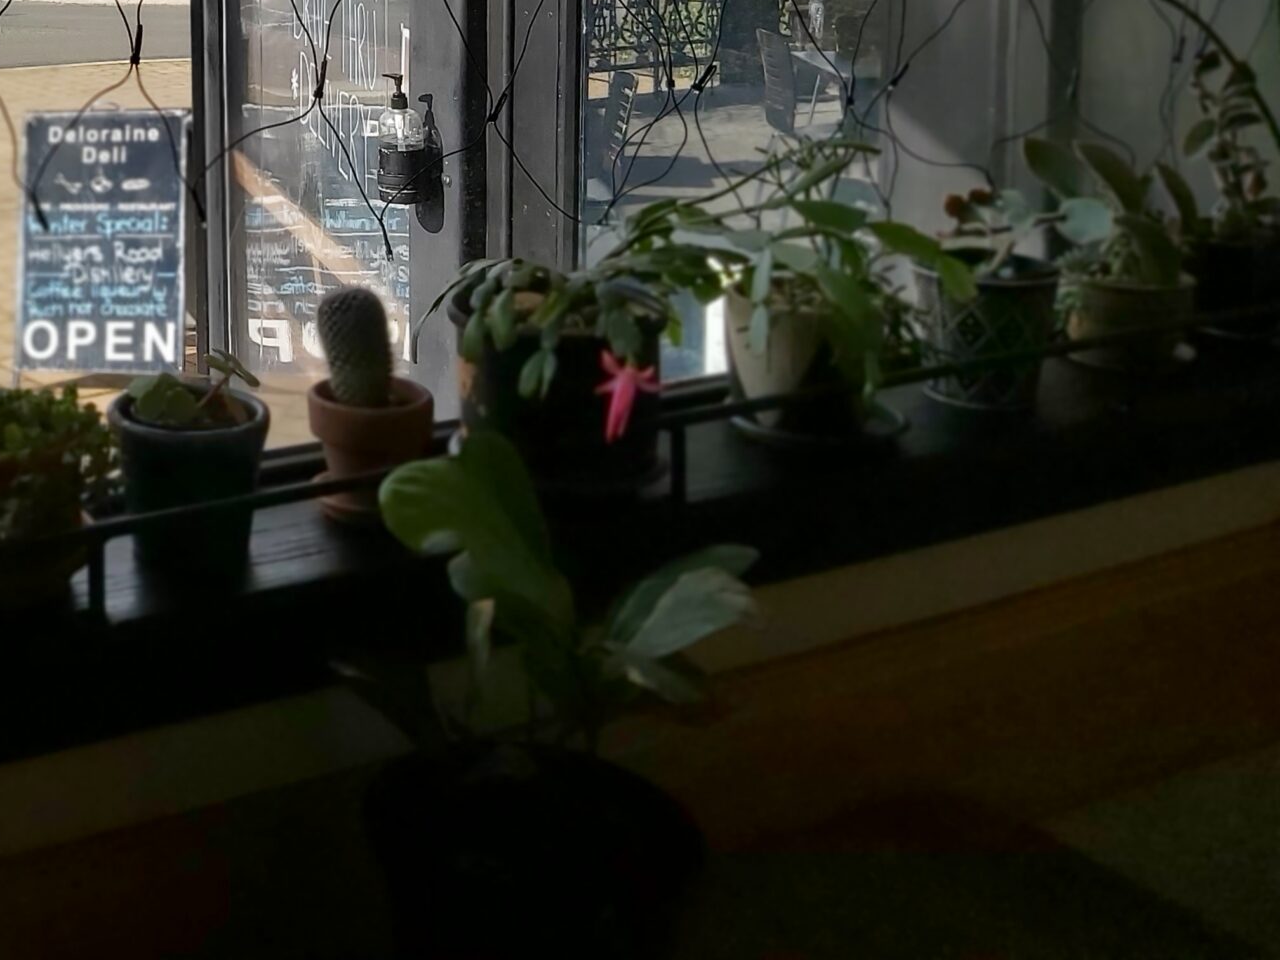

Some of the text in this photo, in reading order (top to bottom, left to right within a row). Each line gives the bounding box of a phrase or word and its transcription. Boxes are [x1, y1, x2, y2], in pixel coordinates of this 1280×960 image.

[47, 125, 160, 143] Deloraine
[81, 145, 127, 164] Deli
[26, 213, 88, 234] Wnter
[23, 319, 176, 363] OPEN
